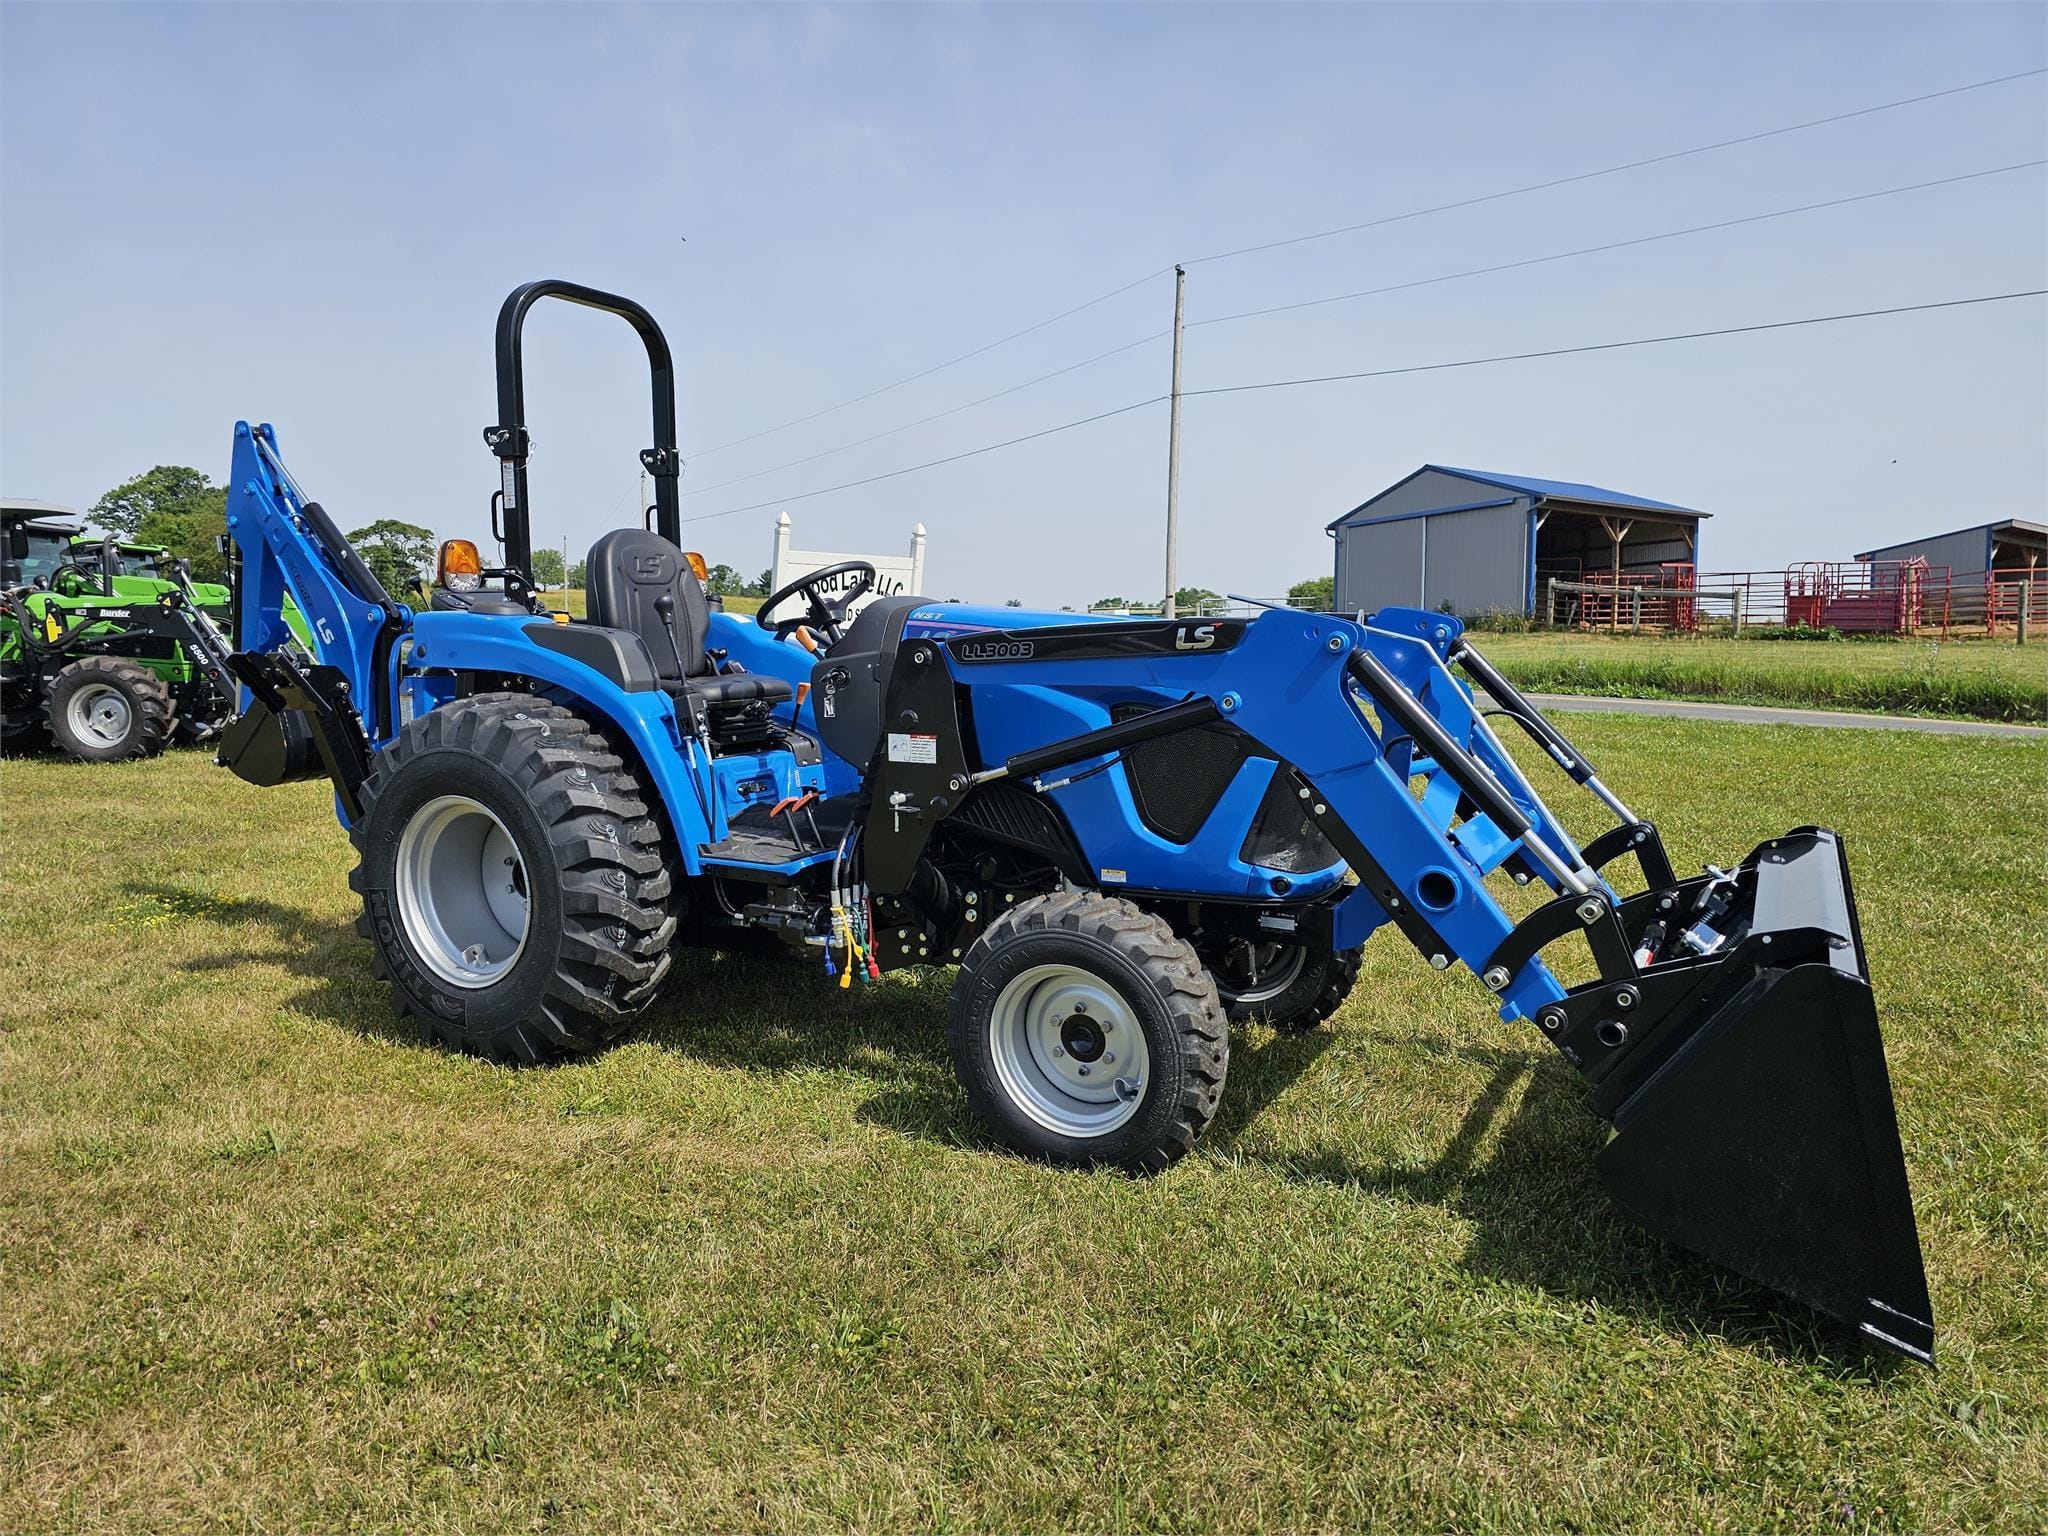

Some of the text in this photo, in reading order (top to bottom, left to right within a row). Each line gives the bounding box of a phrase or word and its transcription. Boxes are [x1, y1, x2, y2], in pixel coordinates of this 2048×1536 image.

[633, 556, 661, 578] LS
[799, 574, 838, 600] ood
[315, 617, 335, 645] LS
[1175, 625, 1215, 650] LS
[961, 641, 1035, 660] LL3003
